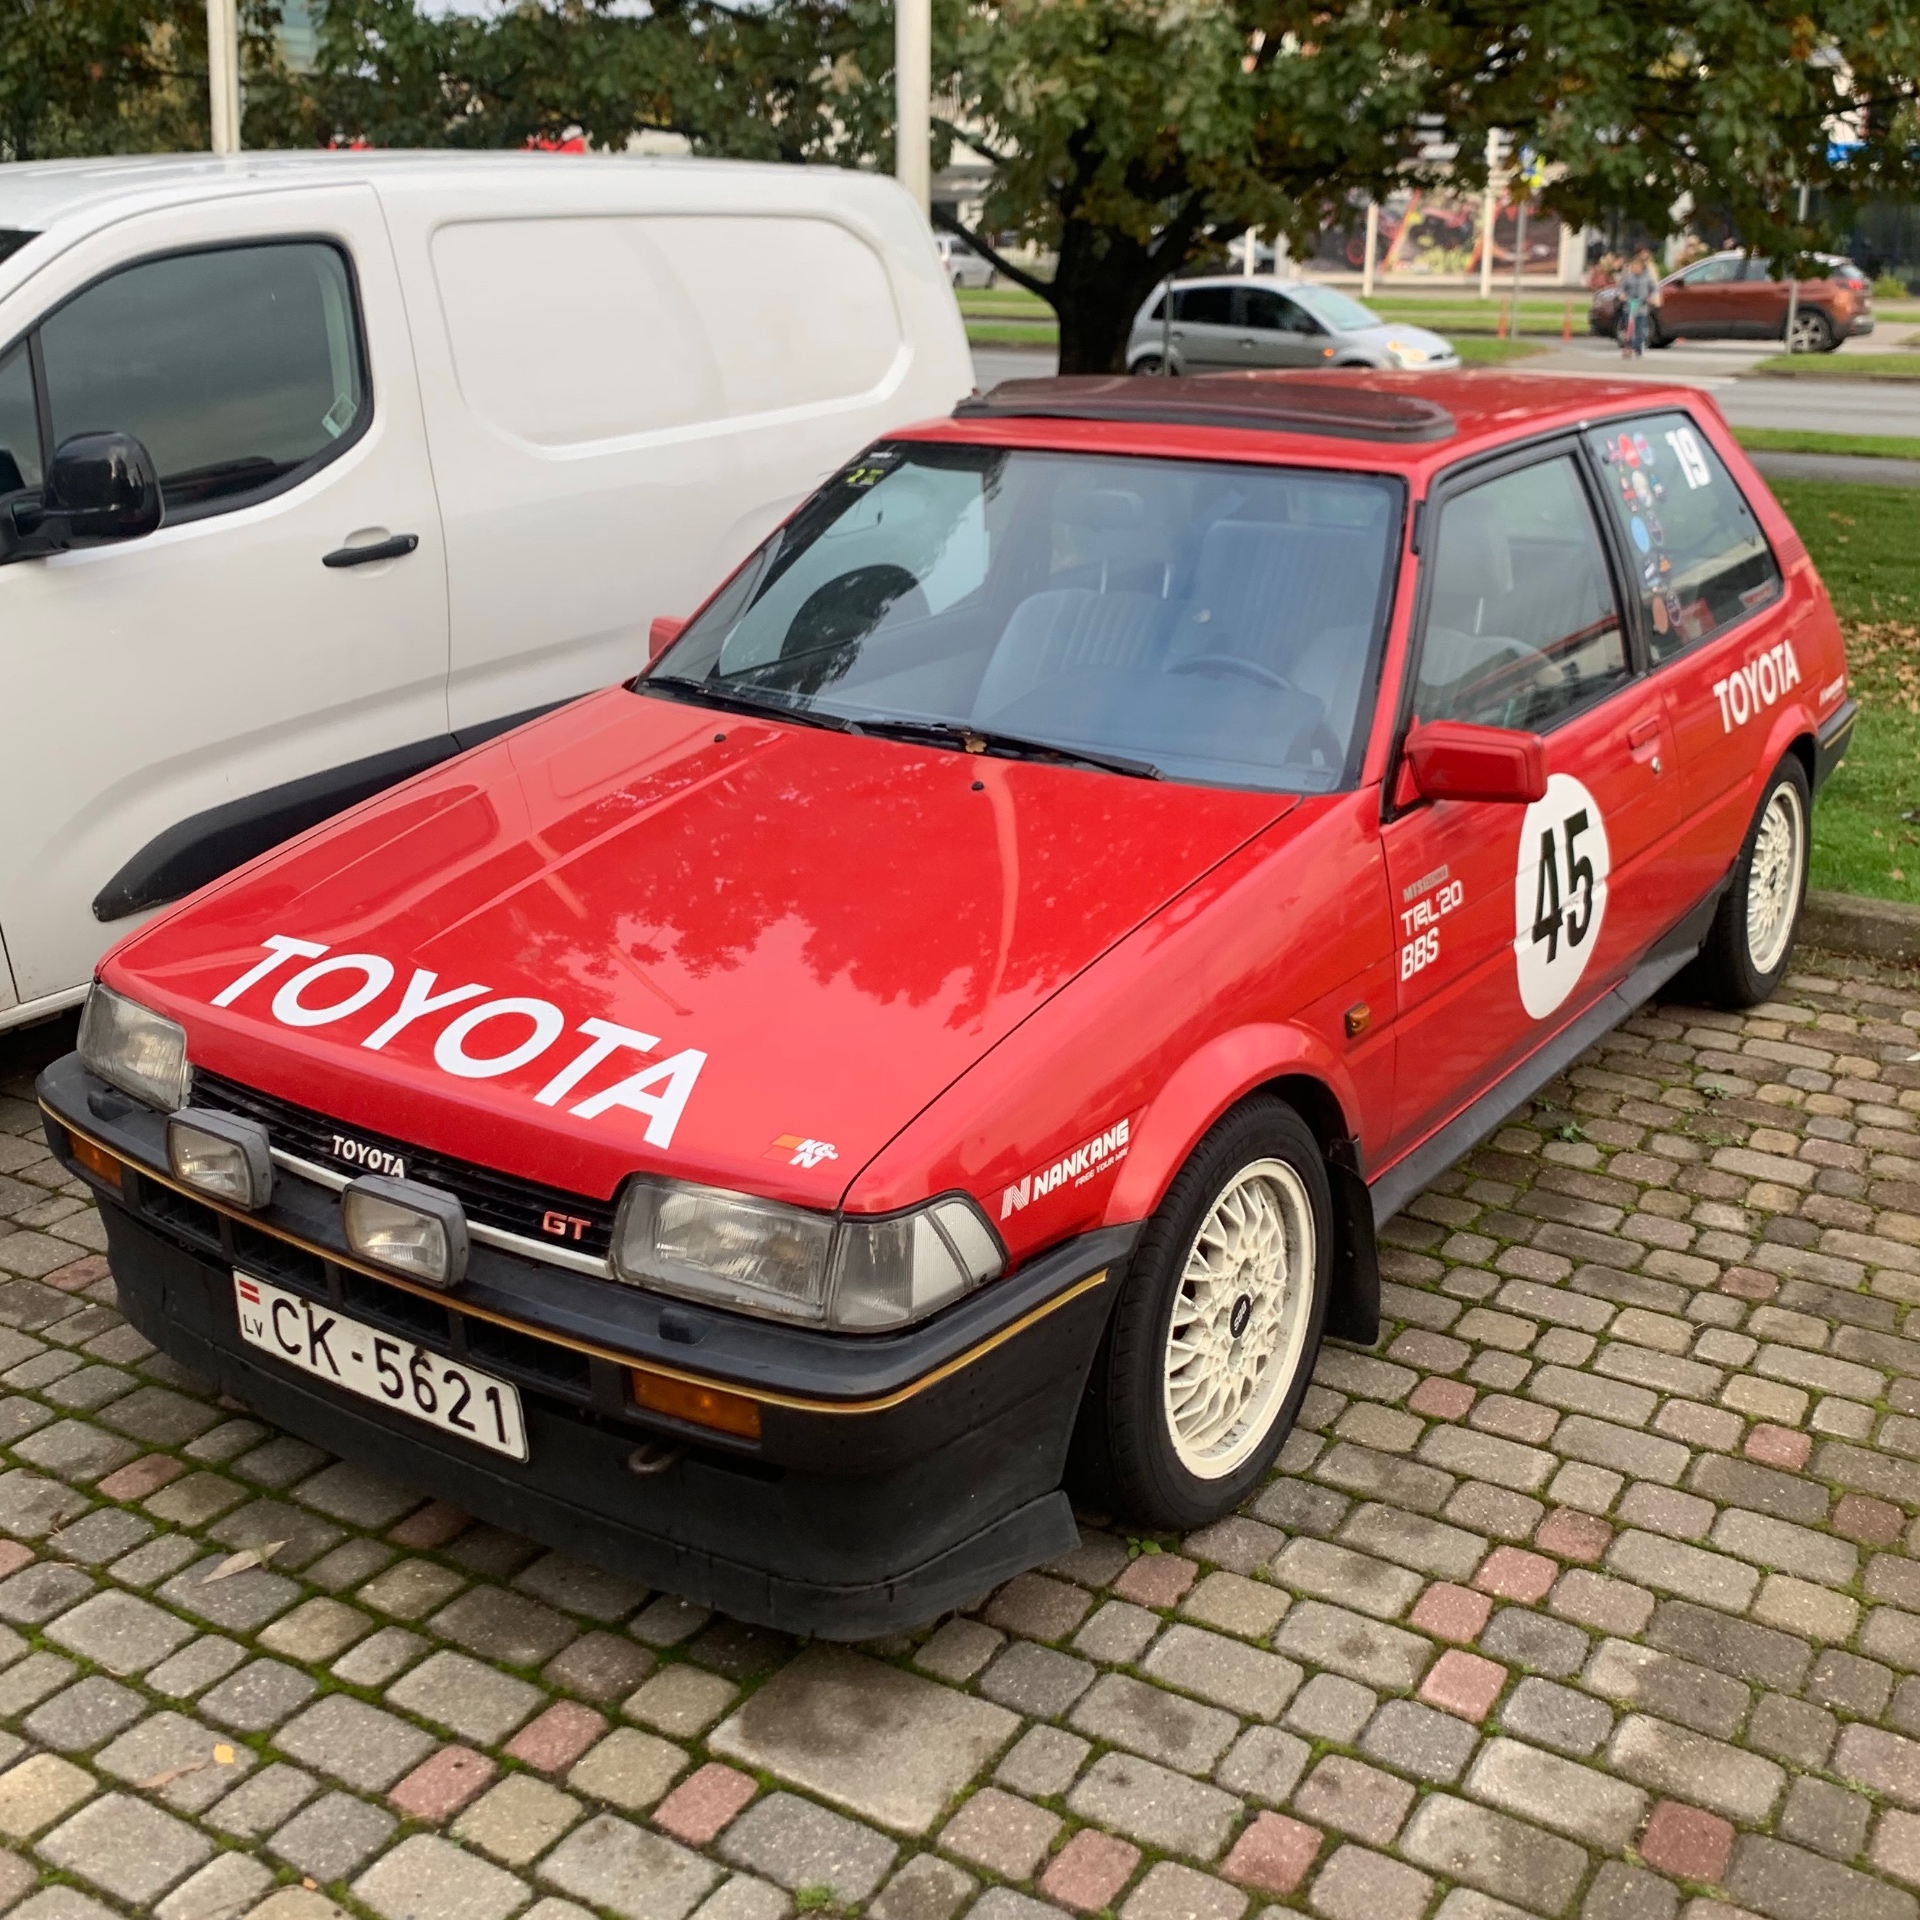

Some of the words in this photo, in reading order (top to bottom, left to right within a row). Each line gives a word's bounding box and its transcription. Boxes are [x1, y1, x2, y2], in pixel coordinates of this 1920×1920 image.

[1665, 426, 1712, 490] 19
[1713, 639, 1800, 734] TOYOTA
[1532, 808, 1594, 965] 45
[1401, 926, 1440, 982] BBS
[210, 934, 709, 1150] TOYOTA
[333, 1134, 405, 1178] TOYOTA
[1033, 1118, 1130, 1202] NANKANG
[543, 1211, 591, 1240] GT
[243, 1313, 263, 1339] LV
